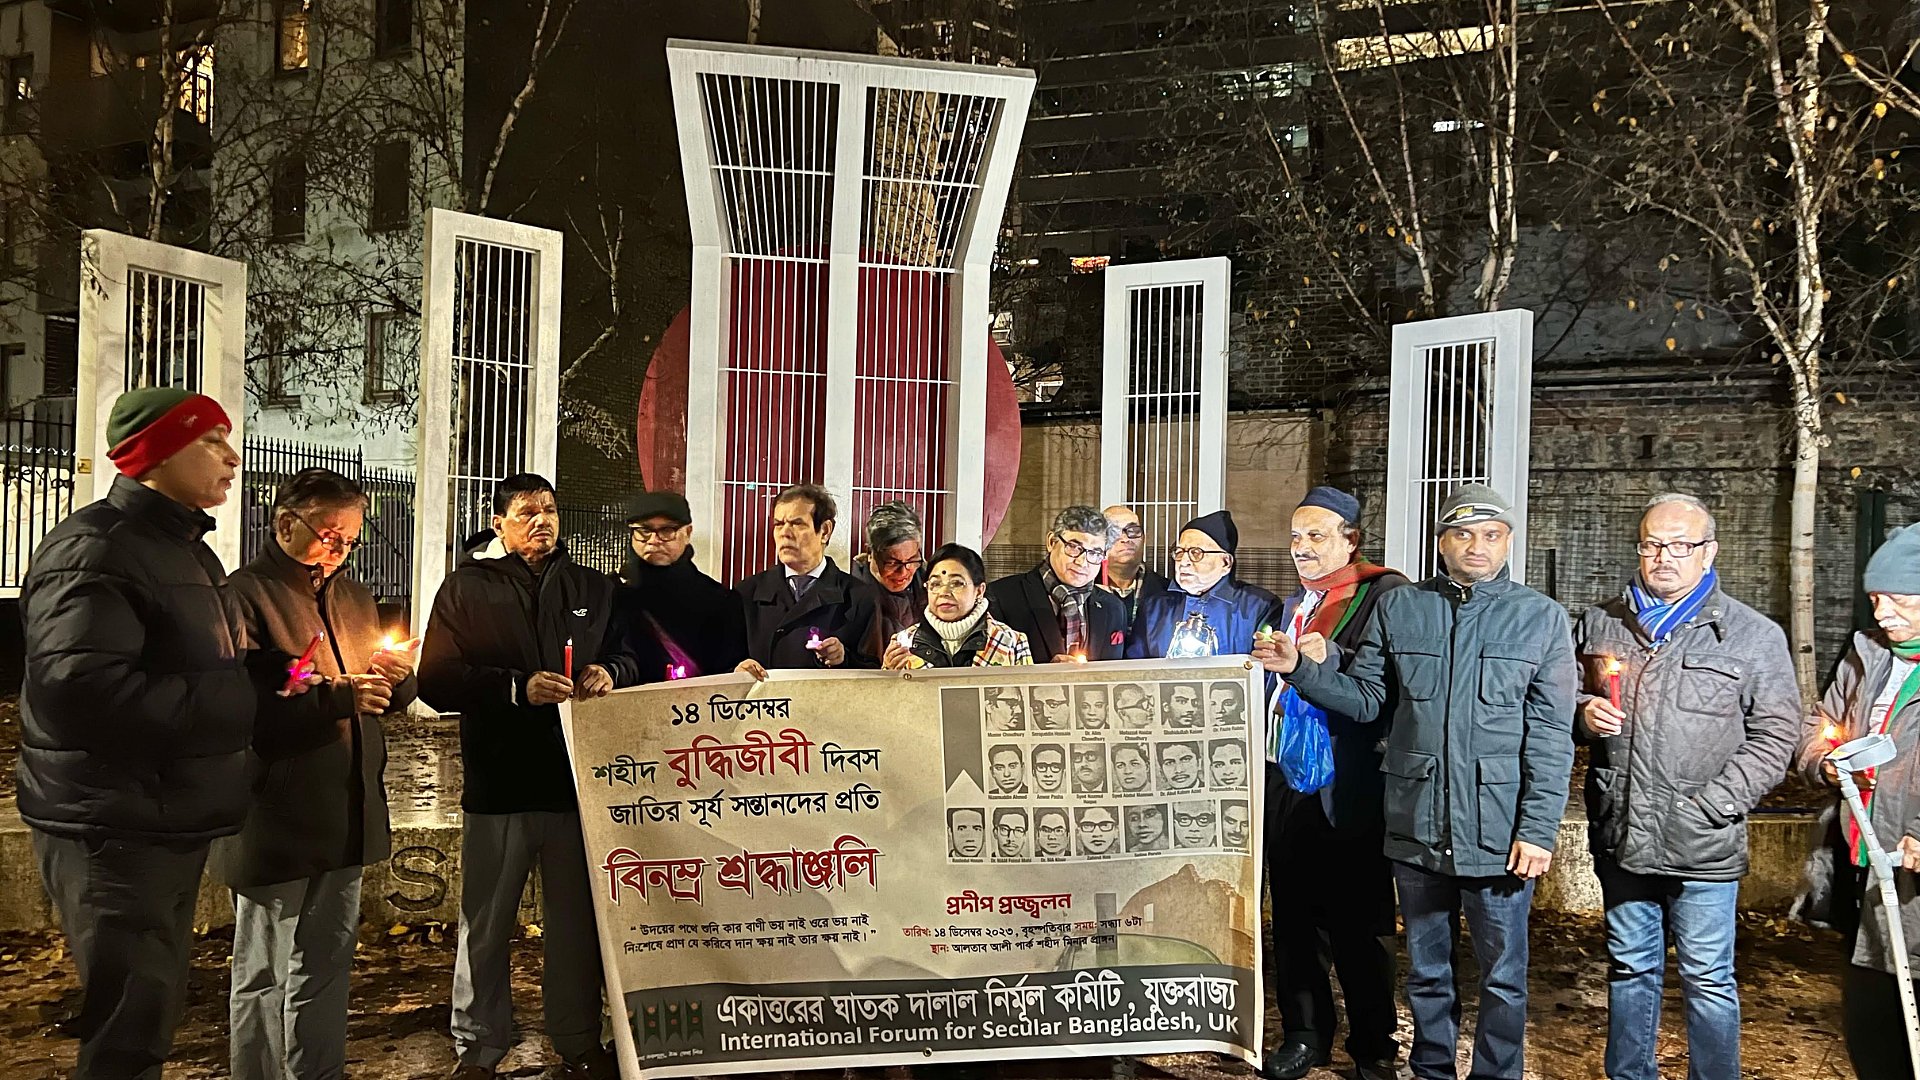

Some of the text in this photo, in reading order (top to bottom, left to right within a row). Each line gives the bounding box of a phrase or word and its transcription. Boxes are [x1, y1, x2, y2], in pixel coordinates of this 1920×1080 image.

[671, 694, 791, 725] ১৪ ডিসেম্বর
[592, 728, 881, 789] শহীদ বুদ্ধিজীবী দিবস
[608, 784, 880, 827] জাতির সূর্য সন্তানদের প্রতি
[601, 834, 884, 906] বিনম্র শ্রদ্ধাঞ্জলি
[947, 890, 994, 914] প্রদীপ
[640, 924, 674, 935] উদয়ের
[679, 924, 697, 933] পথে
[701, 922, 719, 934] শুনি
[723, 923, 741, 933] কার
[745, 918, 765, 932] বাণী
[768, 920, 784, 930] ভয়
[787, 917, 806, 929] নাই
[809, 918, 829, 928] ওরে
[832, 917, 848, 926] ভয়
[851, 914, 869, 926] নাই
[934, 928, 946, 937] ১৪
[949, 925, 982, 937] ডিসেম্বর
[1125, 916, 1142, 926] ৬টা
[666, 939, 684, 948] প্রাণ
[688, 939, 698, 948] যে
[703, 937, 731, 949] করিবে
[735, 939, 753, 948] দান
[756, 938, 774, 947] ক্ষয়
[776, 933, 796, 946] নাই
[798, 935, 818, 944] তার
[821, 933, 839, 943] ক্ষয়
[990, 940, 1011, 952] আলী
[1015, 939, 1034, 950] পার্ক
[1036, 937, 1060, 948] শহীদ
[717, 993, 826, 1027] একাত্তরের
[830, 992, 901, 1025] ঘাতক
[905, 987, 979, 1020] দালাল
[984, 975, 1047, 1021] নির্মূল
[1141, 973, 1239, 1017] যুক্তরাজ্য
[720, 1012, 1239, 1051] International Forum for Secular Bangladesh, UK
